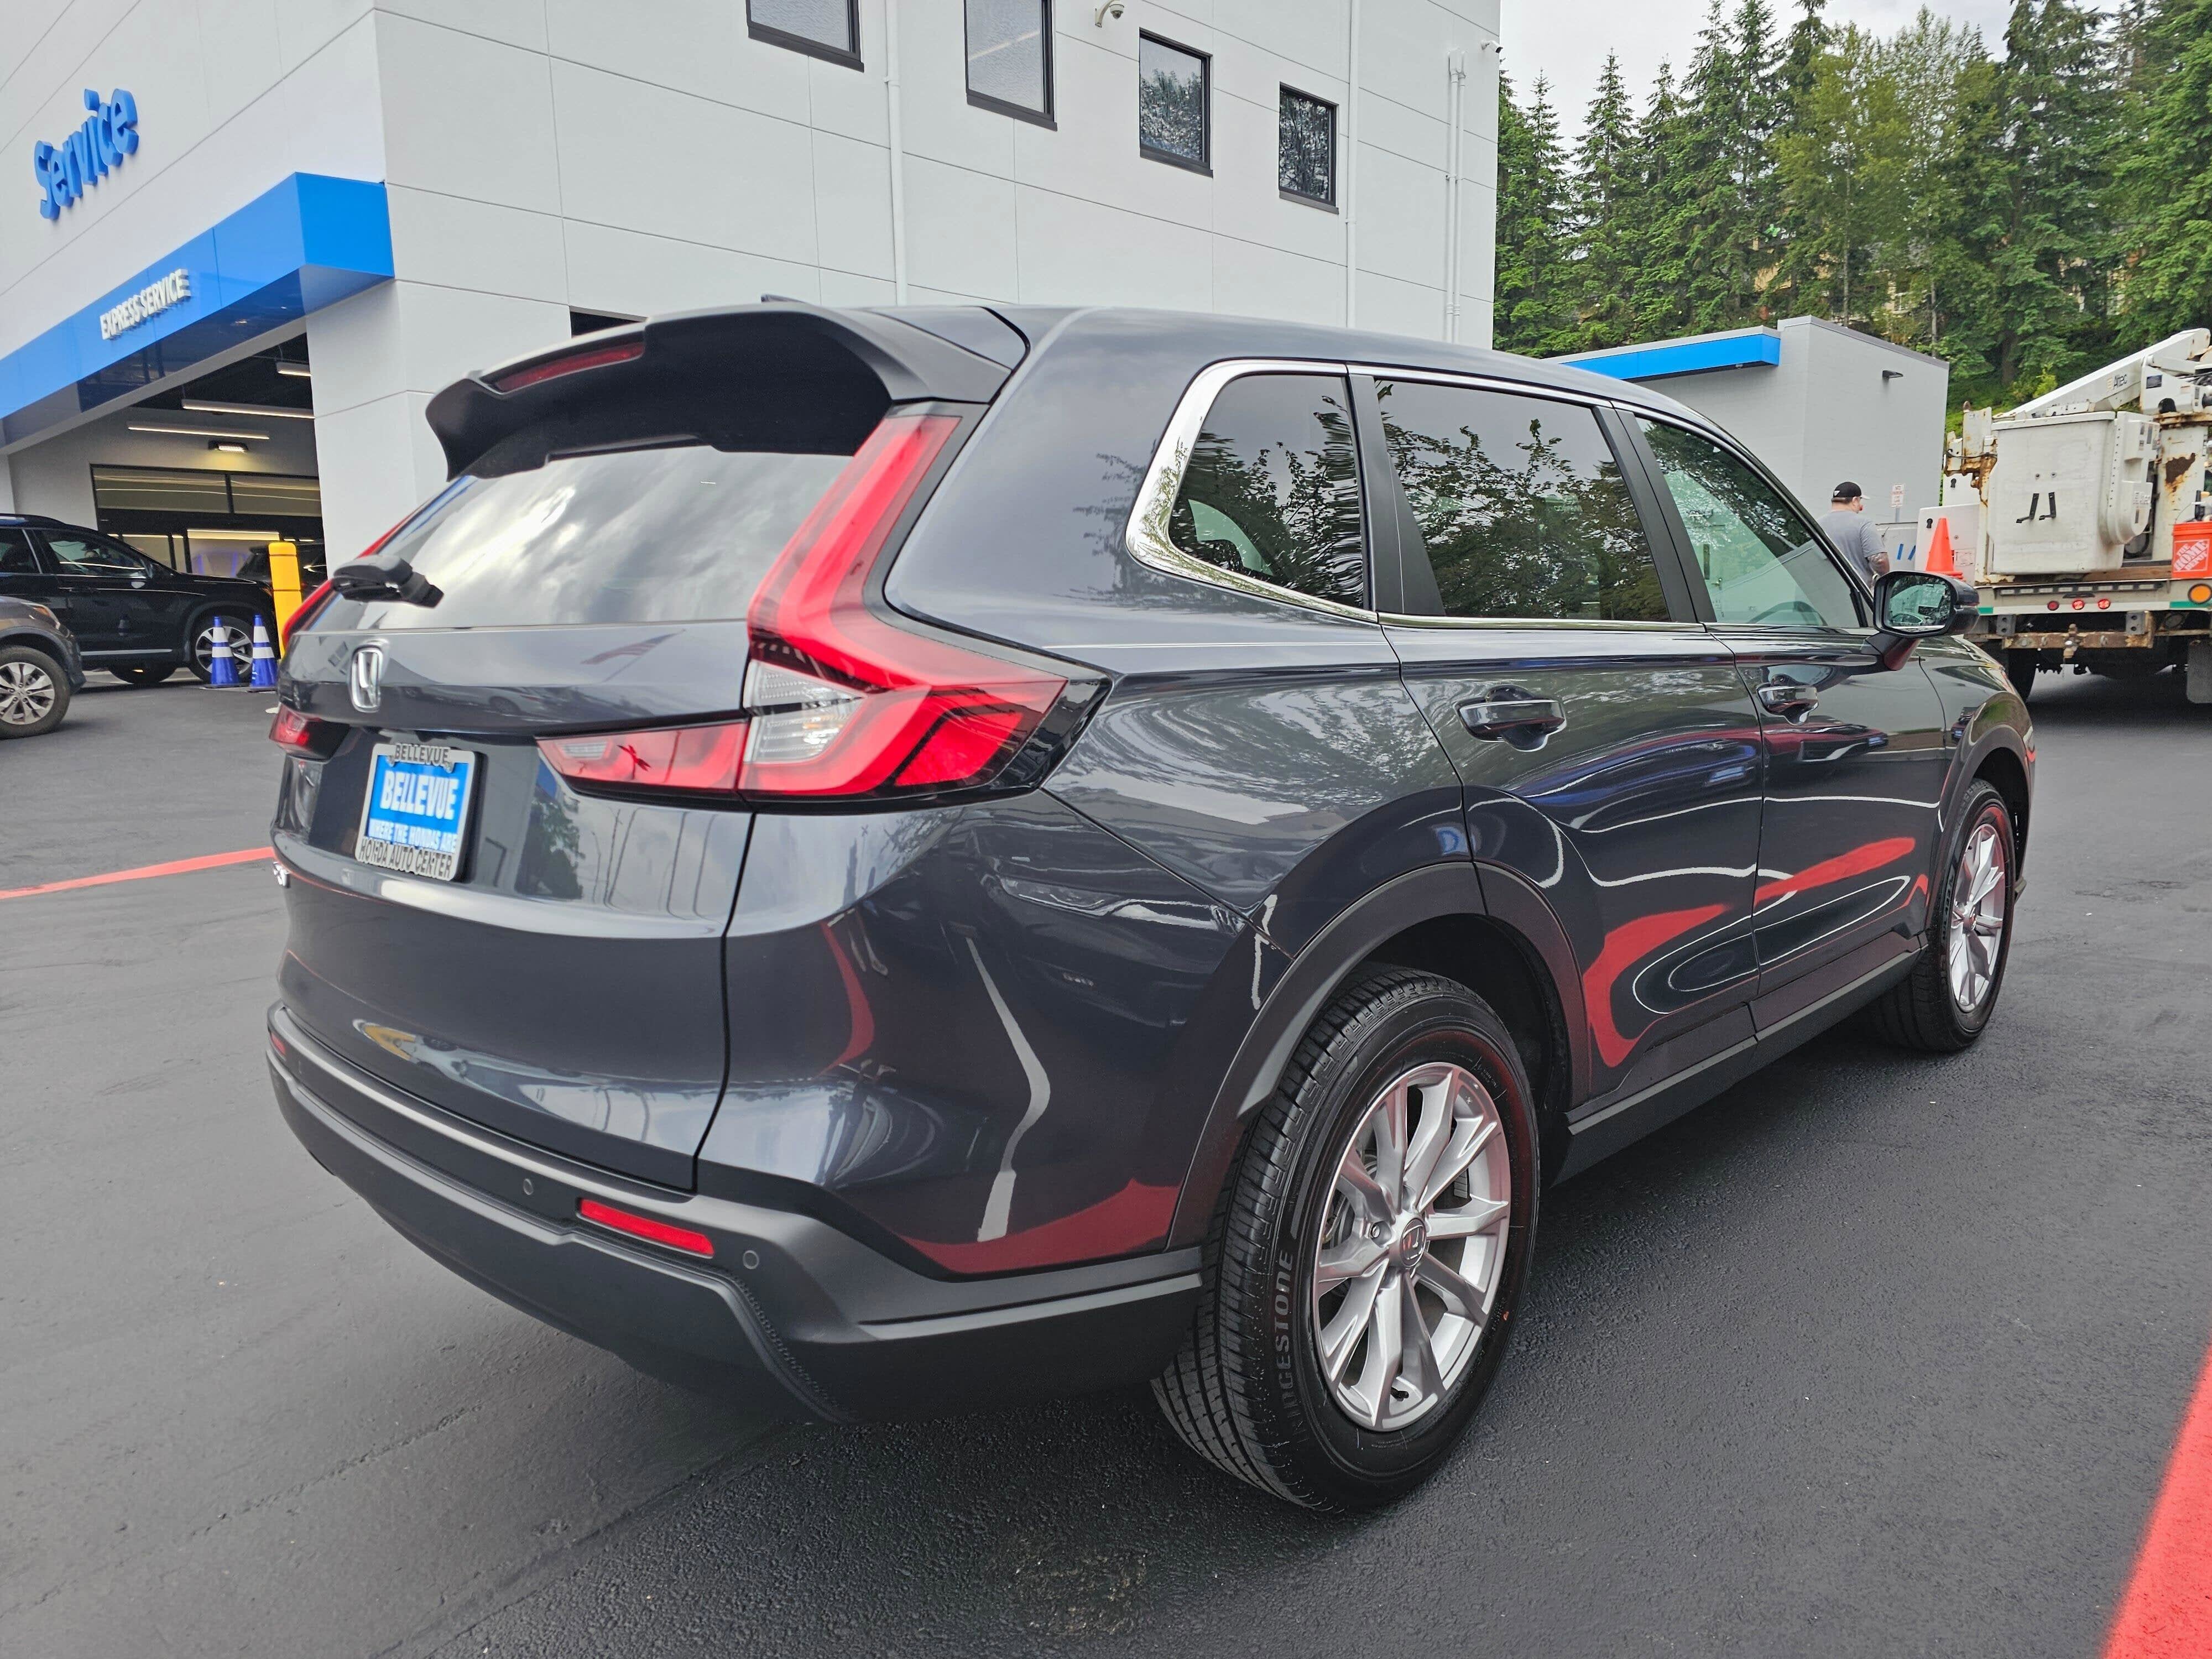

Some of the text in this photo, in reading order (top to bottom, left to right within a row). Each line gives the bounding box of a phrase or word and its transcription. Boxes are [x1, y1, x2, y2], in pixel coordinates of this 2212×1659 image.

[34, 88, 139, 220] Service
[100, 268, 191, 340] EXPRESS SERVICE
[2174, 540, 2207, 571] HOME
[394, 744, 450, 764] BELLEVUE
[380, 770, 460, 820] BELLEVUE
[360, 838, 453, 878] HONDA AUTO CENTER
